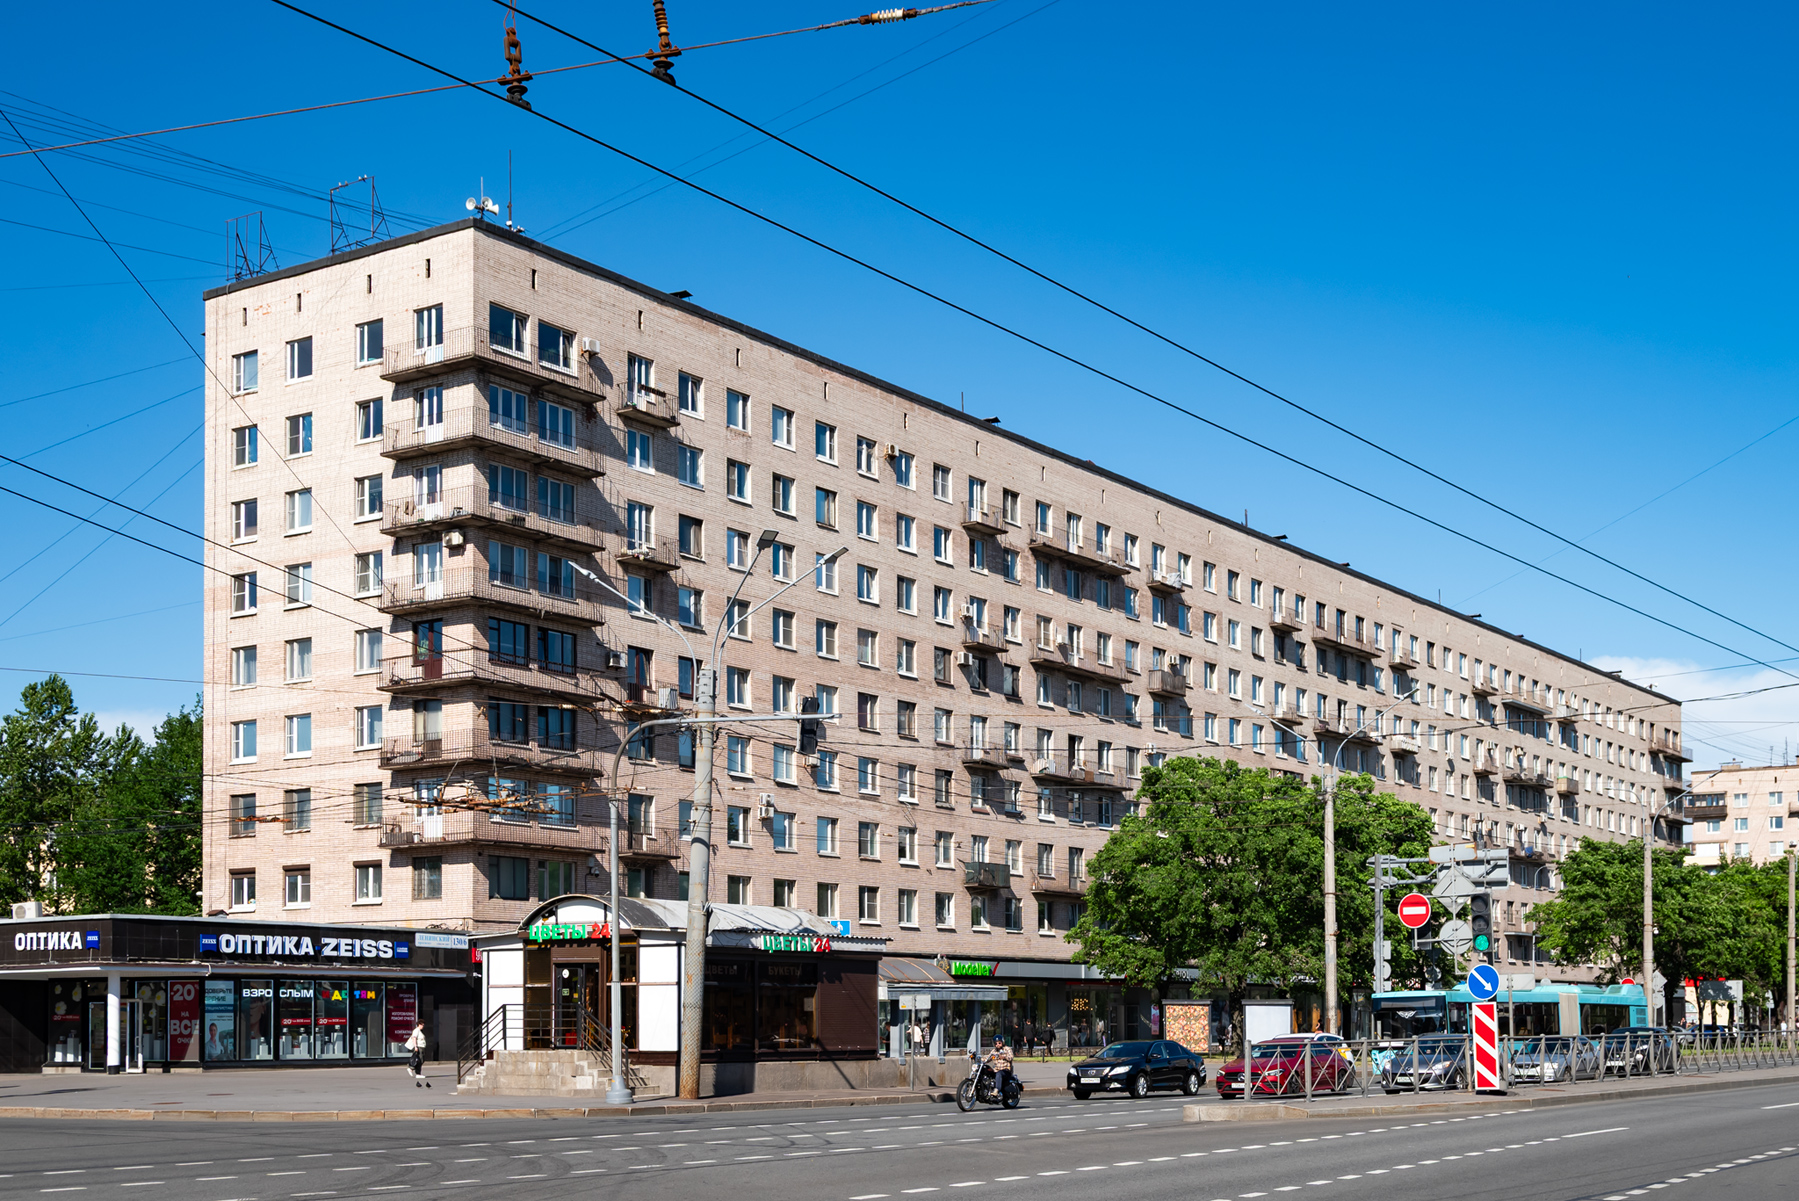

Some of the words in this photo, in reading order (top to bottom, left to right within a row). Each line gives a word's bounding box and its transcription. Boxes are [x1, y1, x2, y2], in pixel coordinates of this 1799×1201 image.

[14, 931, 83, 951] ОПТИКА
[529, 924, 586, 943] ЦВЕТЫ
[591, 922, 611, 939] 24
[218, 933, 315, 956] ОПТИКА
[321, 937, 394, 959] ZEISS
[761, 935, 812, 953] ЦВЕТЫ
[813, 937, 831, 953] 24
[768, 966, 803, 976] БУКЕТЫ
[952, 961, 992, 976] Modeller
